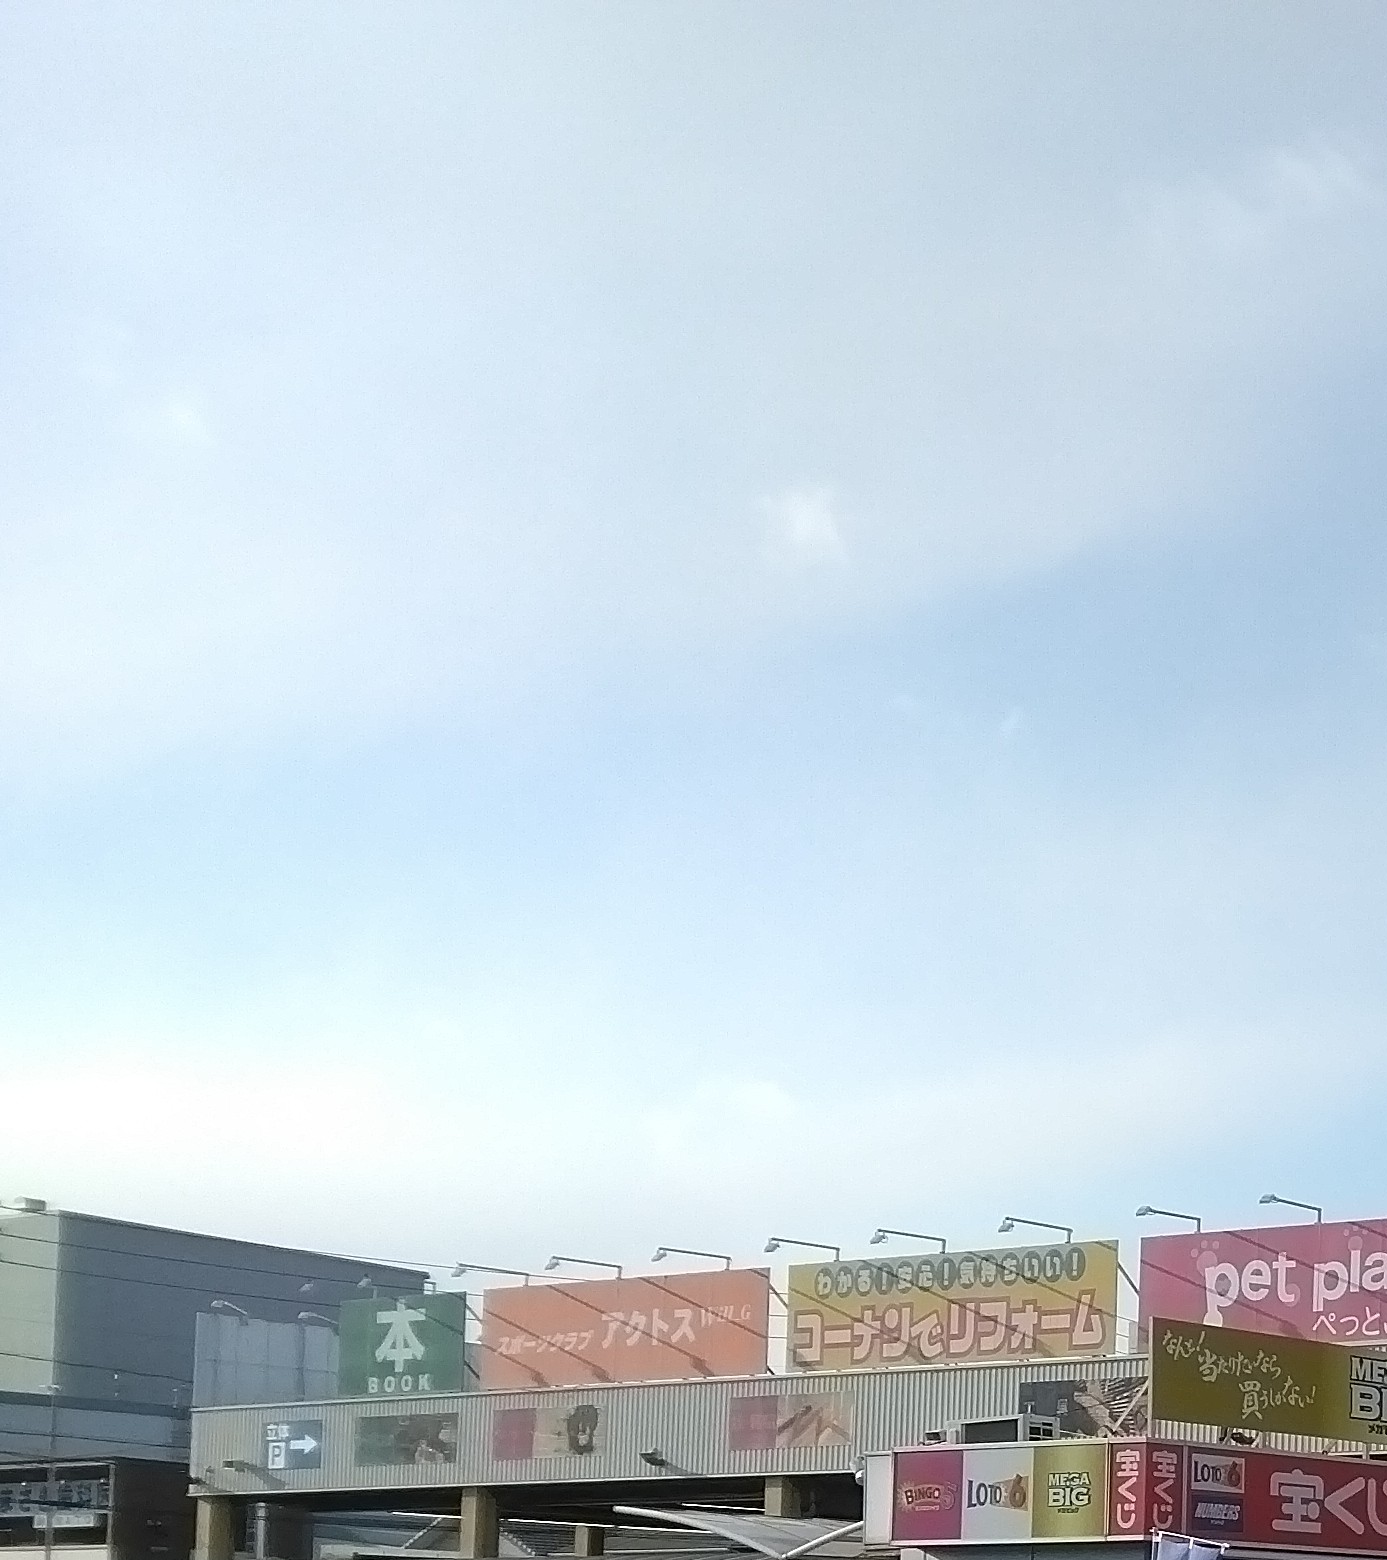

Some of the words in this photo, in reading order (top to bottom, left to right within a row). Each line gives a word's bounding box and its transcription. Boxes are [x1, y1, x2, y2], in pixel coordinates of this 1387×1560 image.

[1203, 1249, 1297, 1327] pet
[376, 1299, 426, 1373] 本
[495, 1330, 594, 1354] スポーツクラブ
[601, 1308, 697, 1349] アクトス
[793, 1289, 1106, 1366] コーナンでリフォーム
[366, 1374, 431, 1394] BOOK
[1047, 1472, 1090, 1487] MEGA
[1047, 1487, 1091, 1508] BIG
[1115, 1449, 1141, 1529] 宝くじ
[1152, 1450, 1178, 1530] 宝くじ
